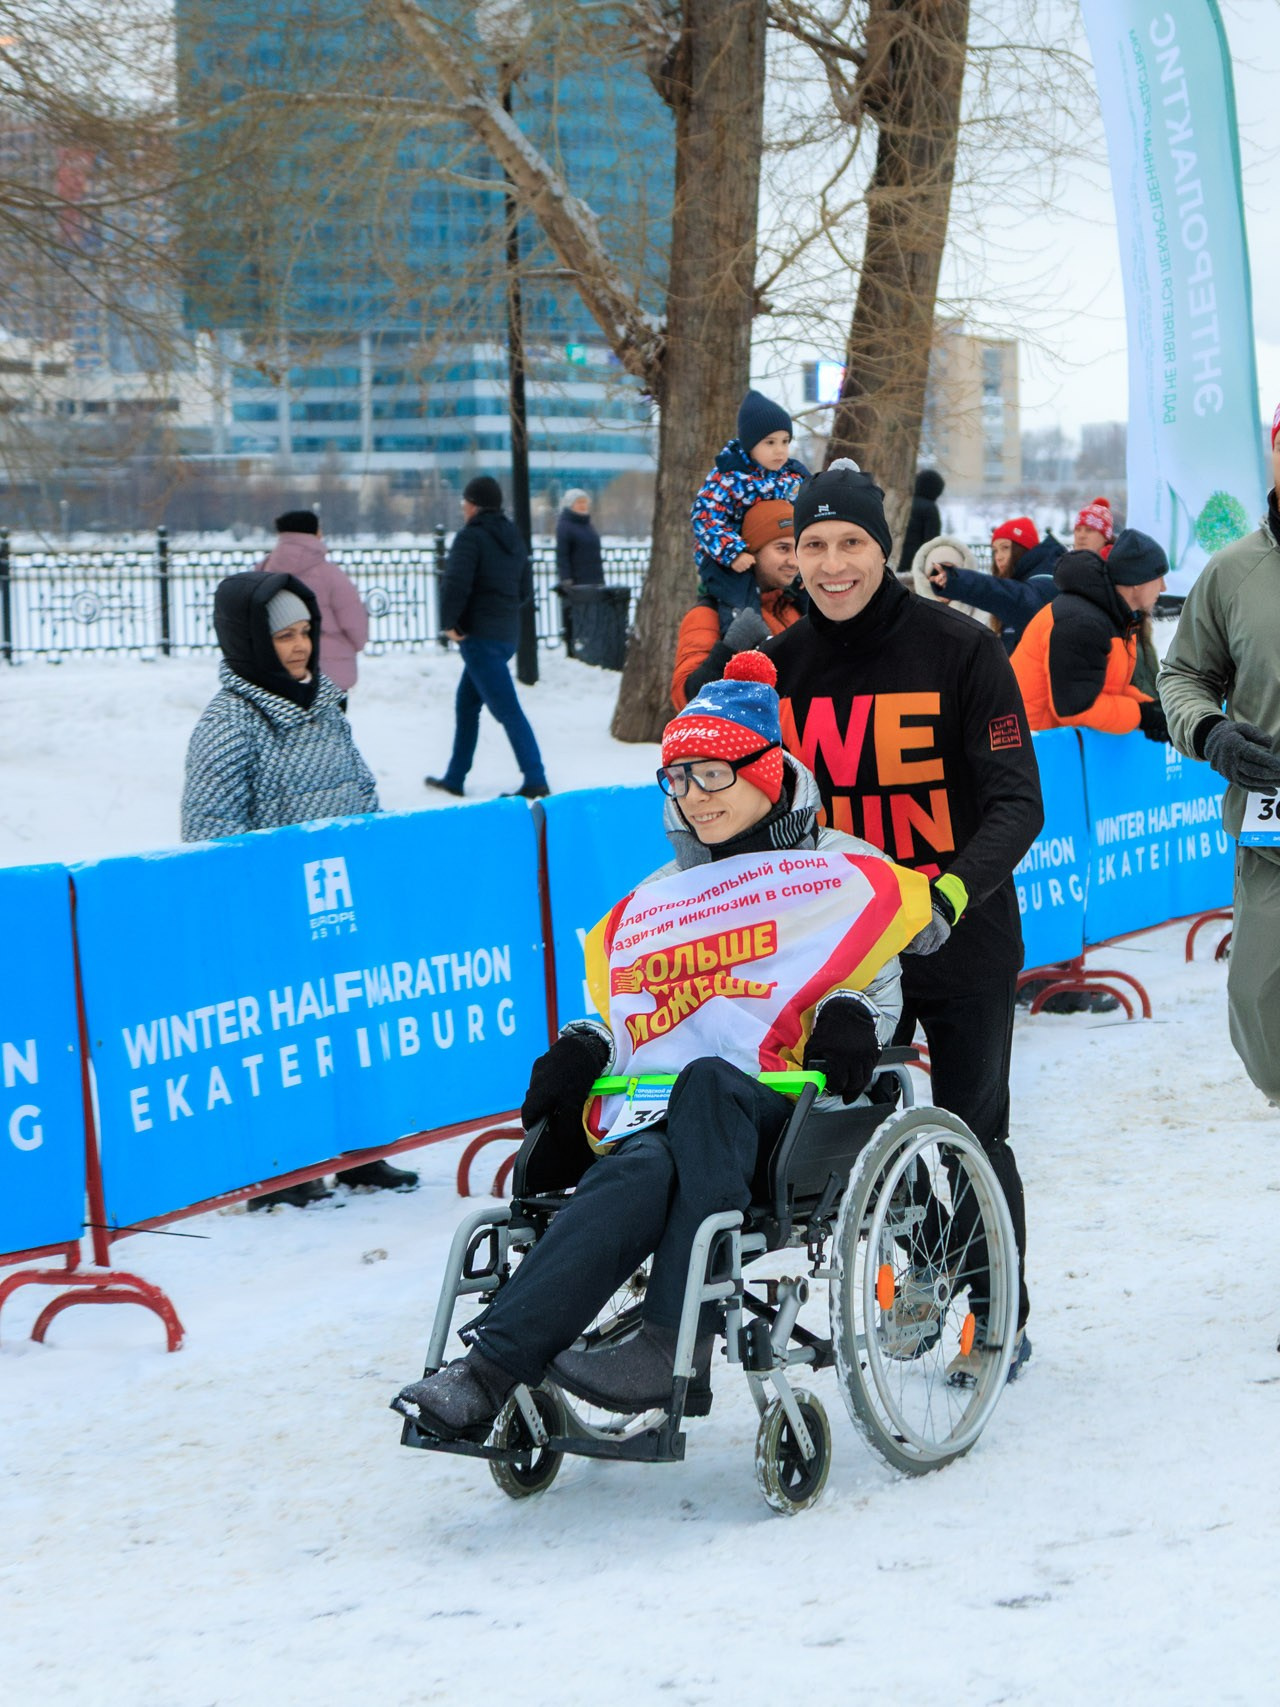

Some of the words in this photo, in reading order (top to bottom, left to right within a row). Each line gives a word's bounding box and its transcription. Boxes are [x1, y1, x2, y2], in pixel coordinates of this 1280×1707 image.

[779, 687, 945, 787] WE
[816, 788, 955, 859] UN
[1096, 811, 1145, 846] WINTER
[778, 857, 829, 876] фонд
[679, 895, 761, 928] инклюзии
[766, 890, 777, 901] в
[781, 876, 842, 897] спорте
[122, 995, 263, 1070] WINTER
[627, 1108, 668, 1128] 30
